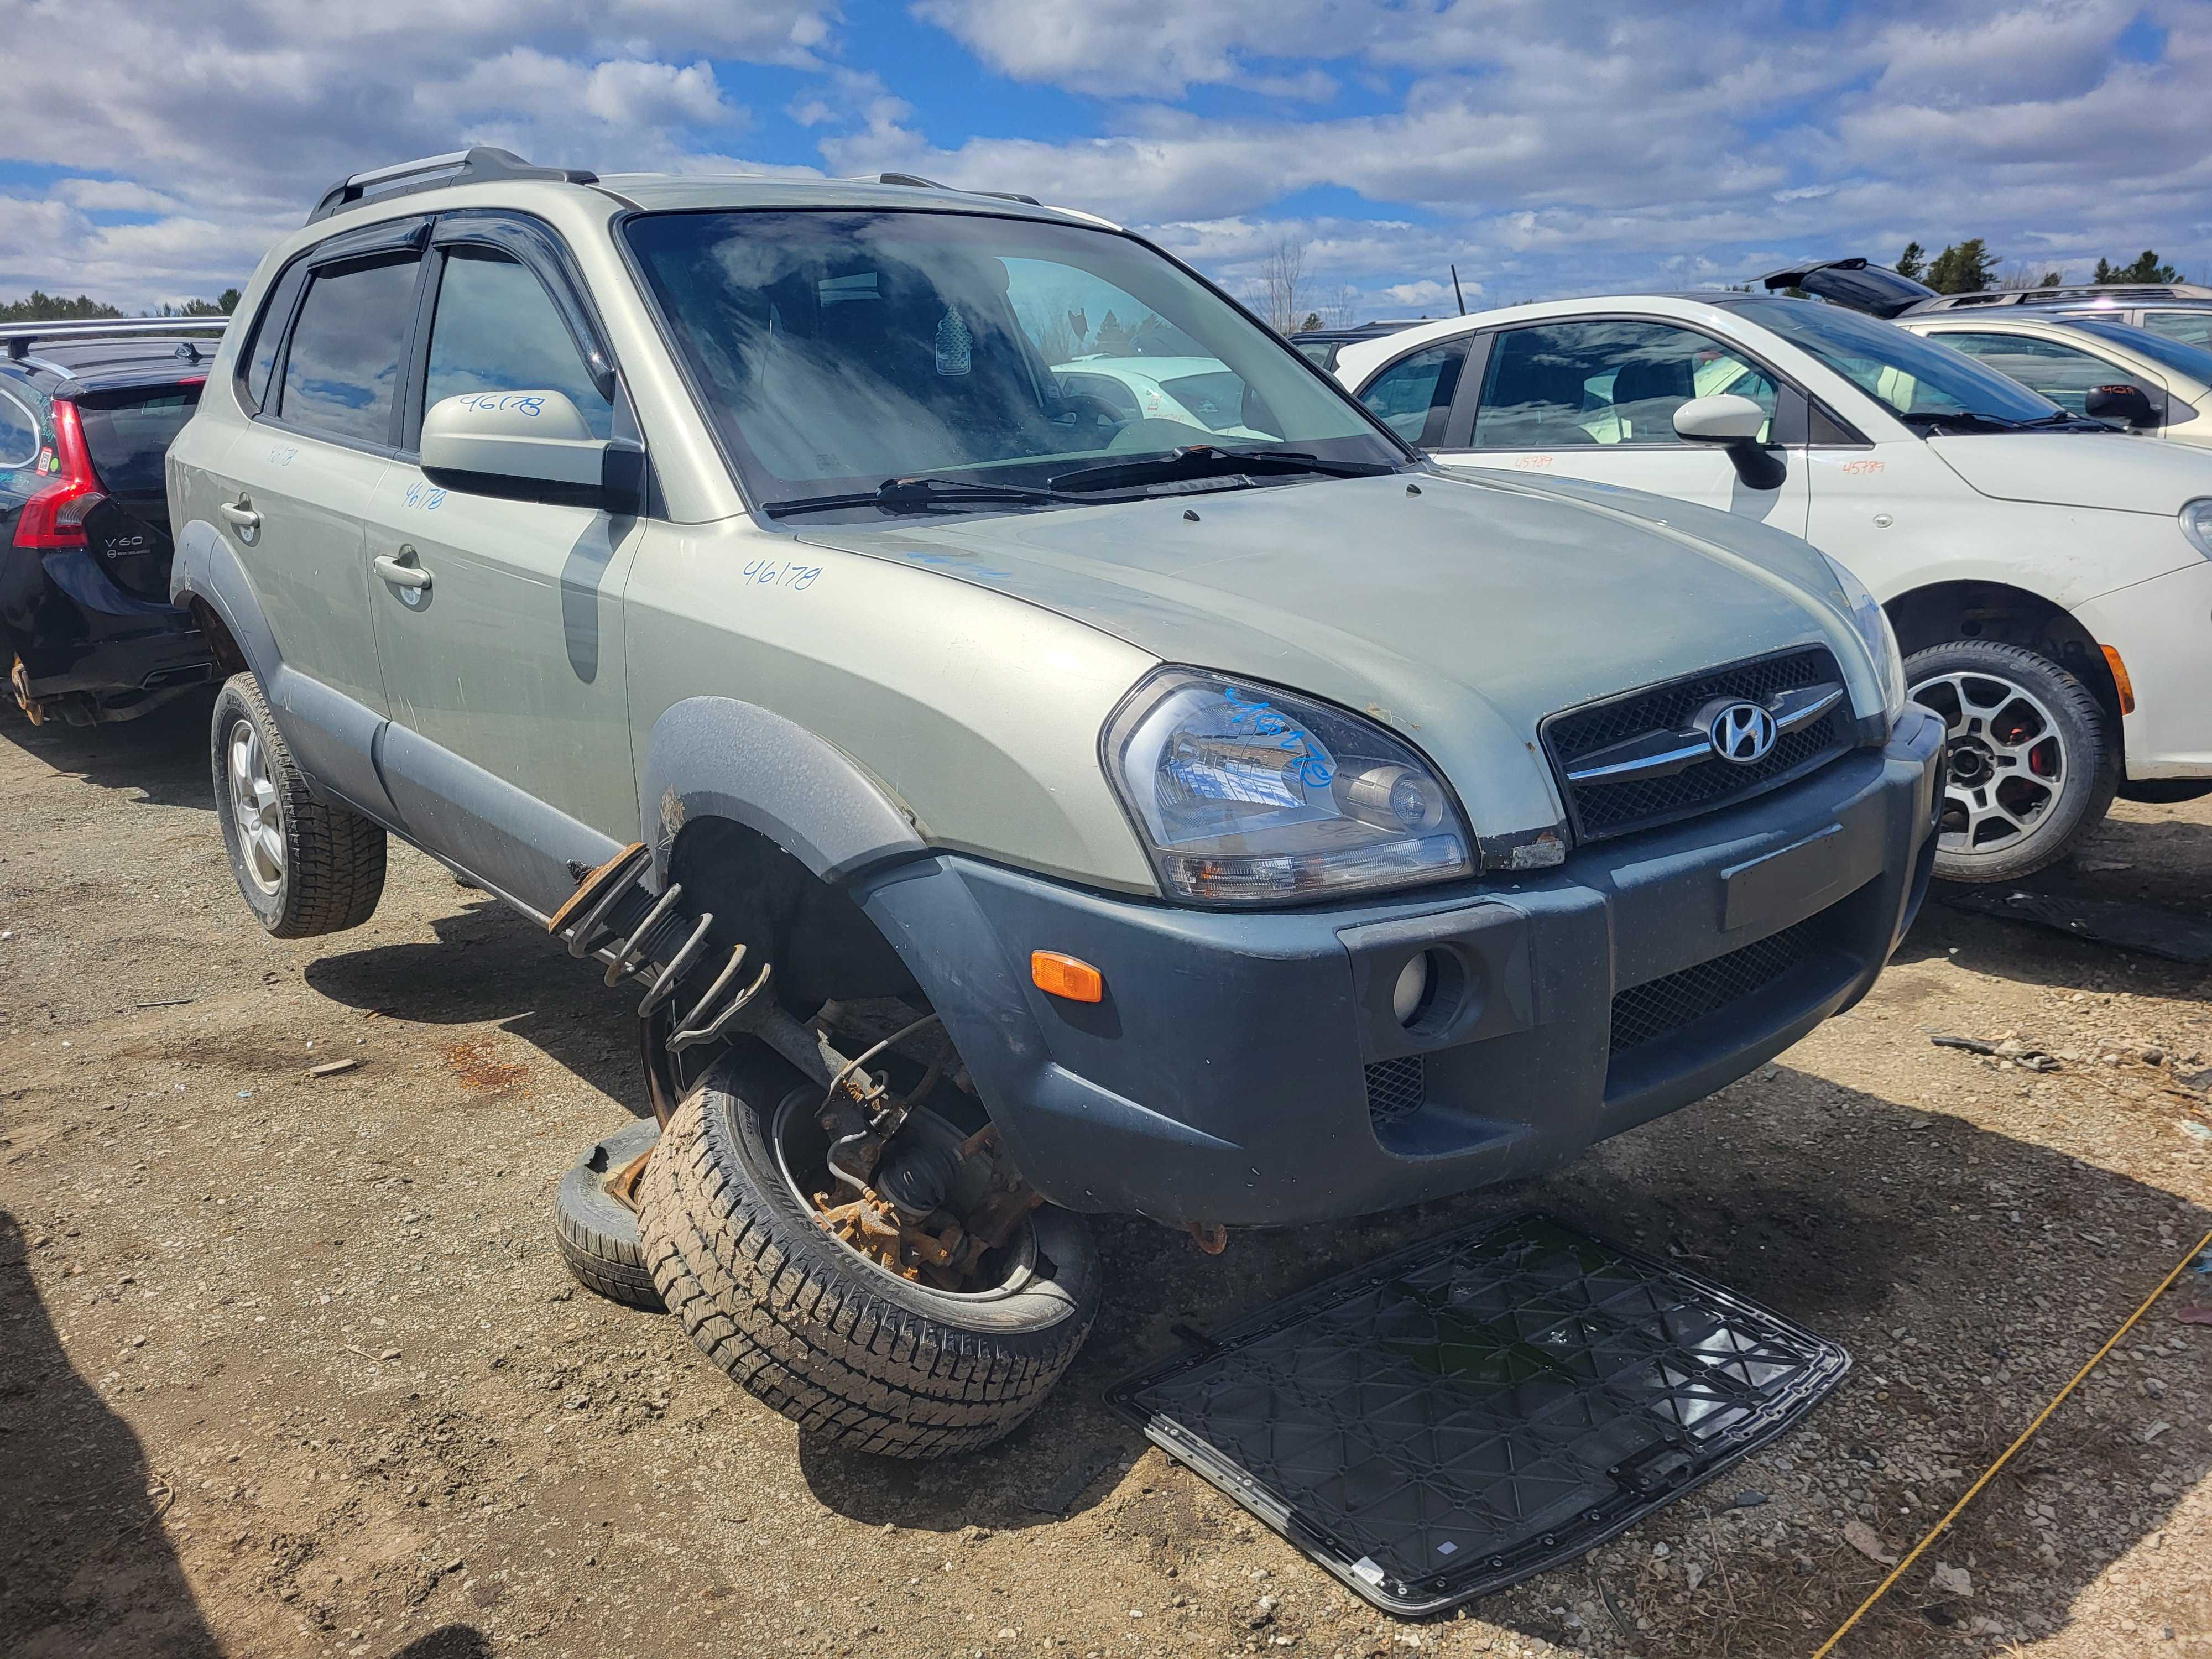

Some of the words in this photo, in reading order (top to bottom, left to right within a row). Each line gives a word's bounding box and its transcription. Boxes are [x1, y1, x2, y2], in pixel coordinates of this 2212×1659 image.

[460, 395, 545, 416] 46178
[401, 482, 447, 509] 46178
[105, 536, 143, 547] V60
[764, 1173, 904, 1296] BRIDGESTONE
